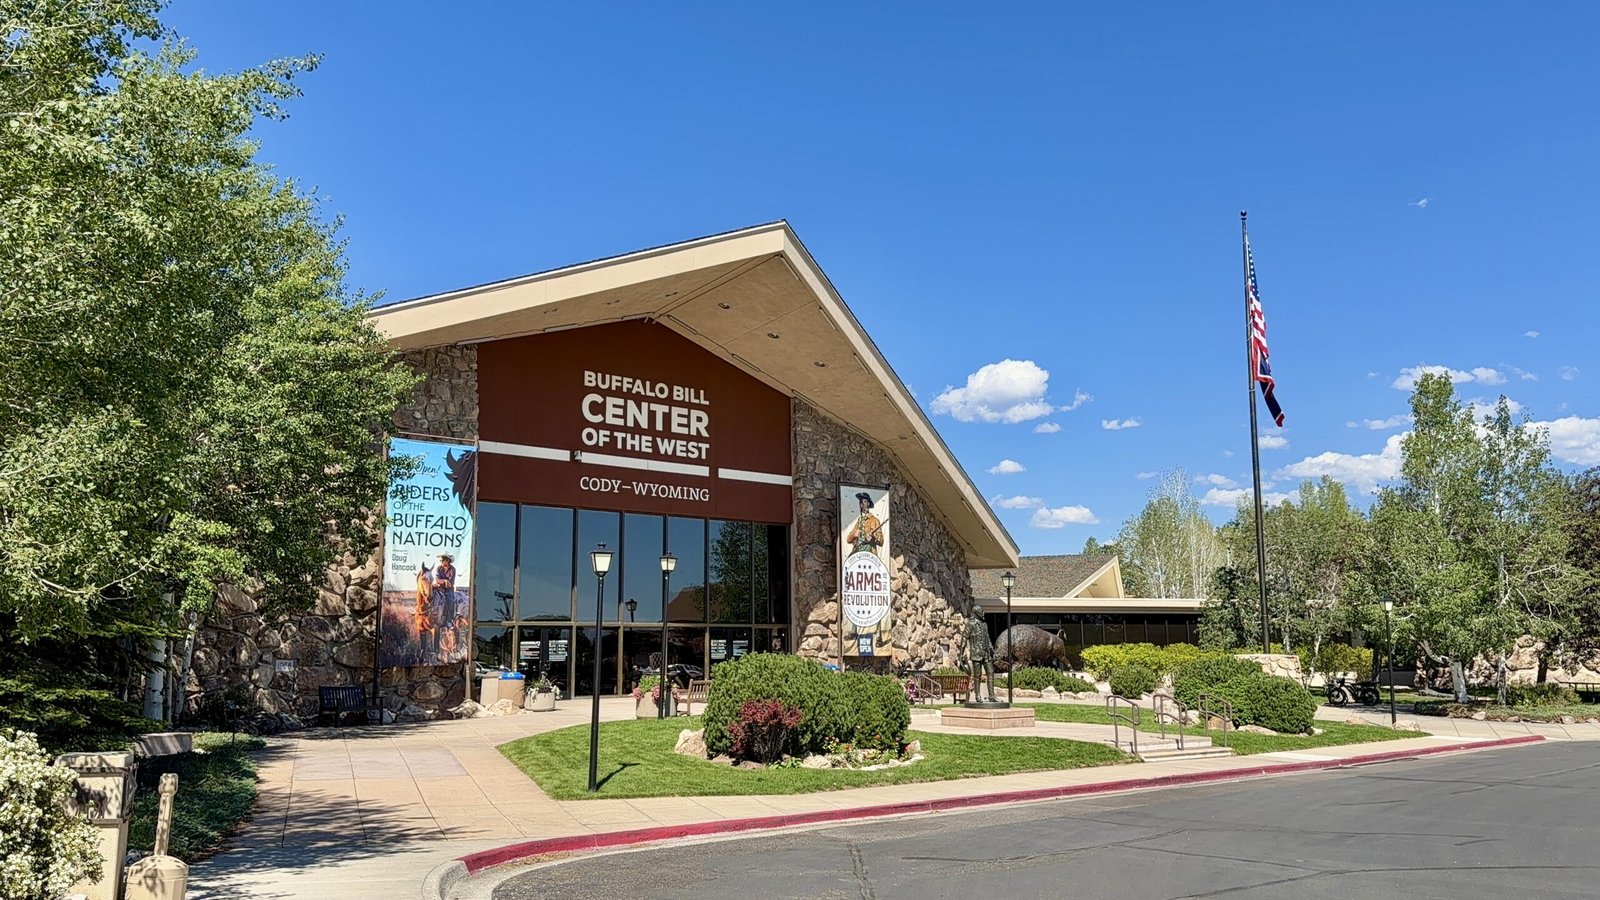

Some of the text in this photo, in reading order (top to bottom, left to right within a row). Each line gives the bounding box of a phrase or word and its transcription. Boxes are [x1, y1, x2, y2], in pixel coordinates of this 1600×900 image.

[584, 370, 710, 405] BUFFALO BILL
[581, 393, 710, 437] CENTER
[581, 427, 710, 460] OF THE WEST
[394, 484, 450, 501] RIDERS
[409, 502, 425, 511] THE
[393, 513, 467, 531] BUFFALO
[392, 531, 462, 548] NATIONS
[391, 553, 407, 563] Doug
[391, 563, 417, 571] Hancock
[847, 571, 882, 592] ARMS
[844, 594, 889, 607] REVOLUTION
